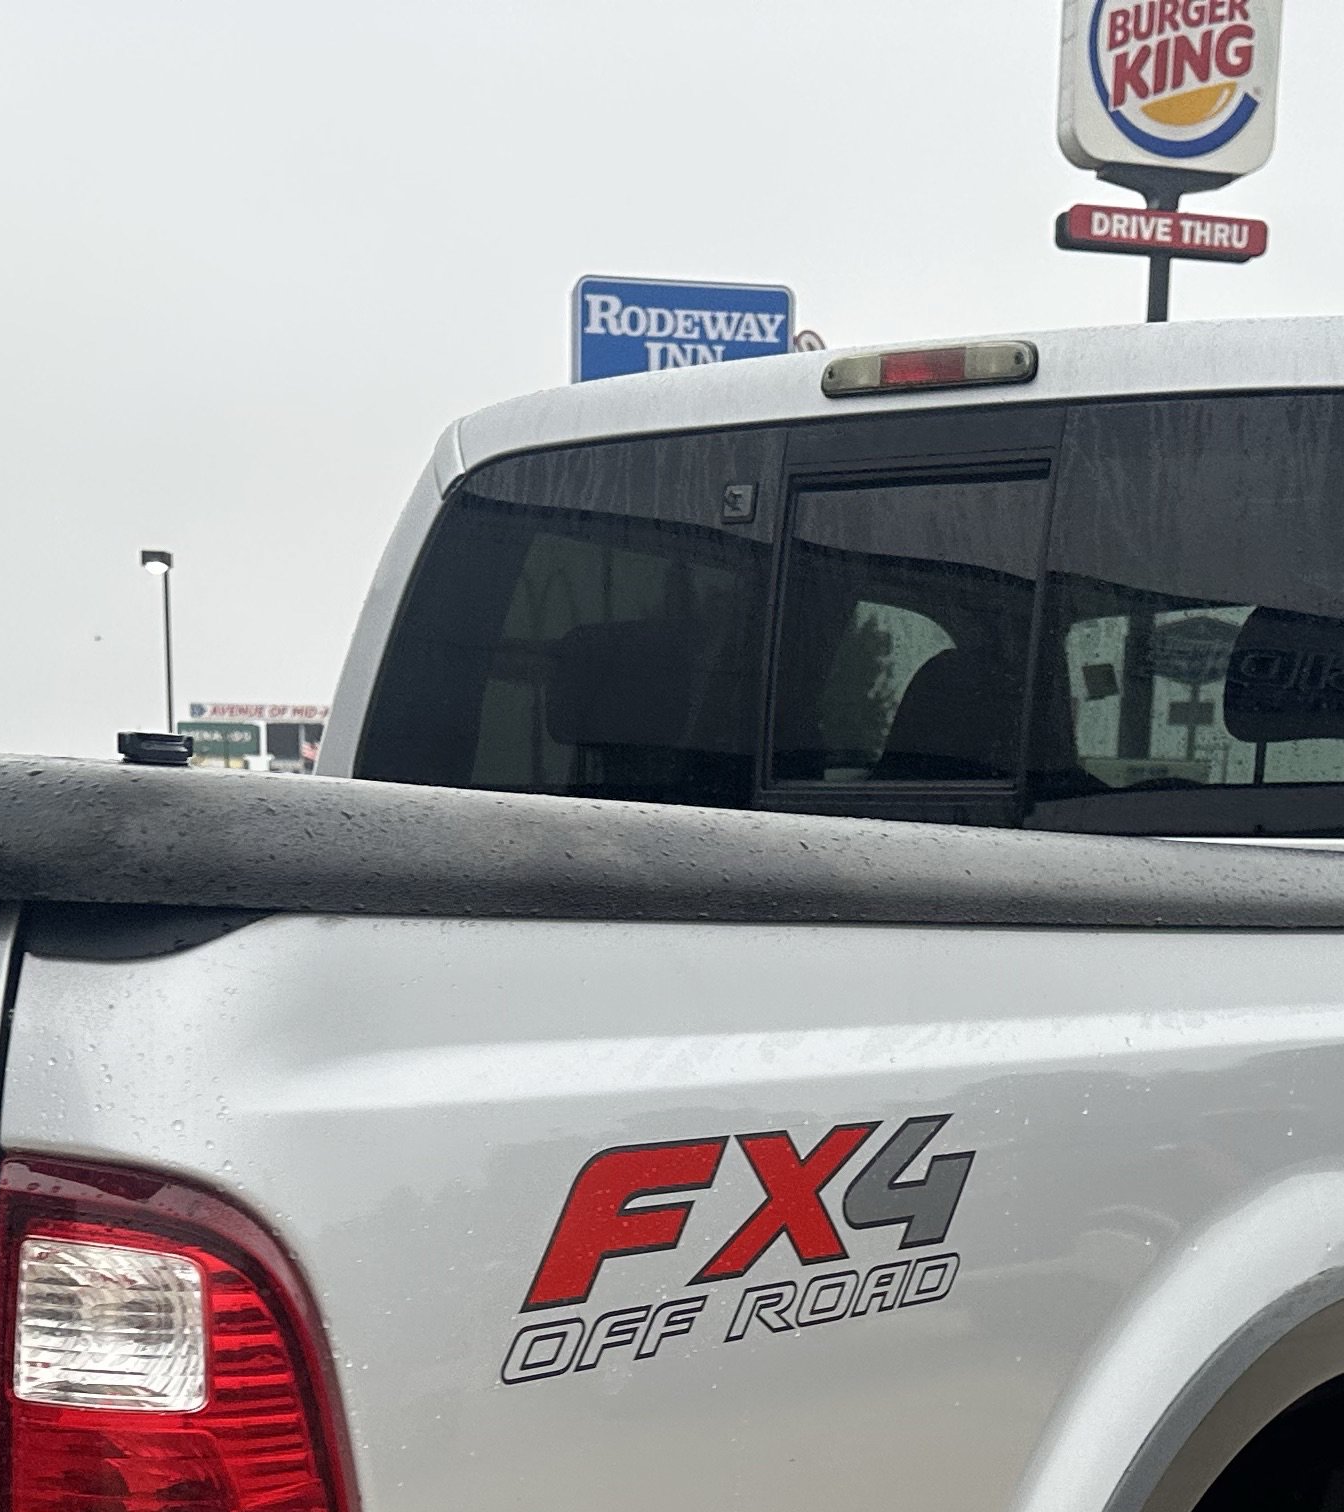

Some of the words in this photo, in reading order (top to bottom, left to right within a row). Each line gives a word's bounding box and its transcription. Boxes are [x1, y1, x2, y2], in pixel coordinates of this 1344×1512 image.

[1108, 0, 1250, 51] BURGER
[1113, 24, 1255, 108] KING
[1090, 211, 1173, 243] DRIVE
[1180, 218, 1250, 250] THRU
[583, 293, 786, 344] RODEWAY
[644, 342, 726, 372] INN
[269, 704, 288, 719] OF
[518, 1112, 976, 1314] FX4
[501, 1294, 709, 1385] OFF
[723, 1252, 960, 1343] ROAD
